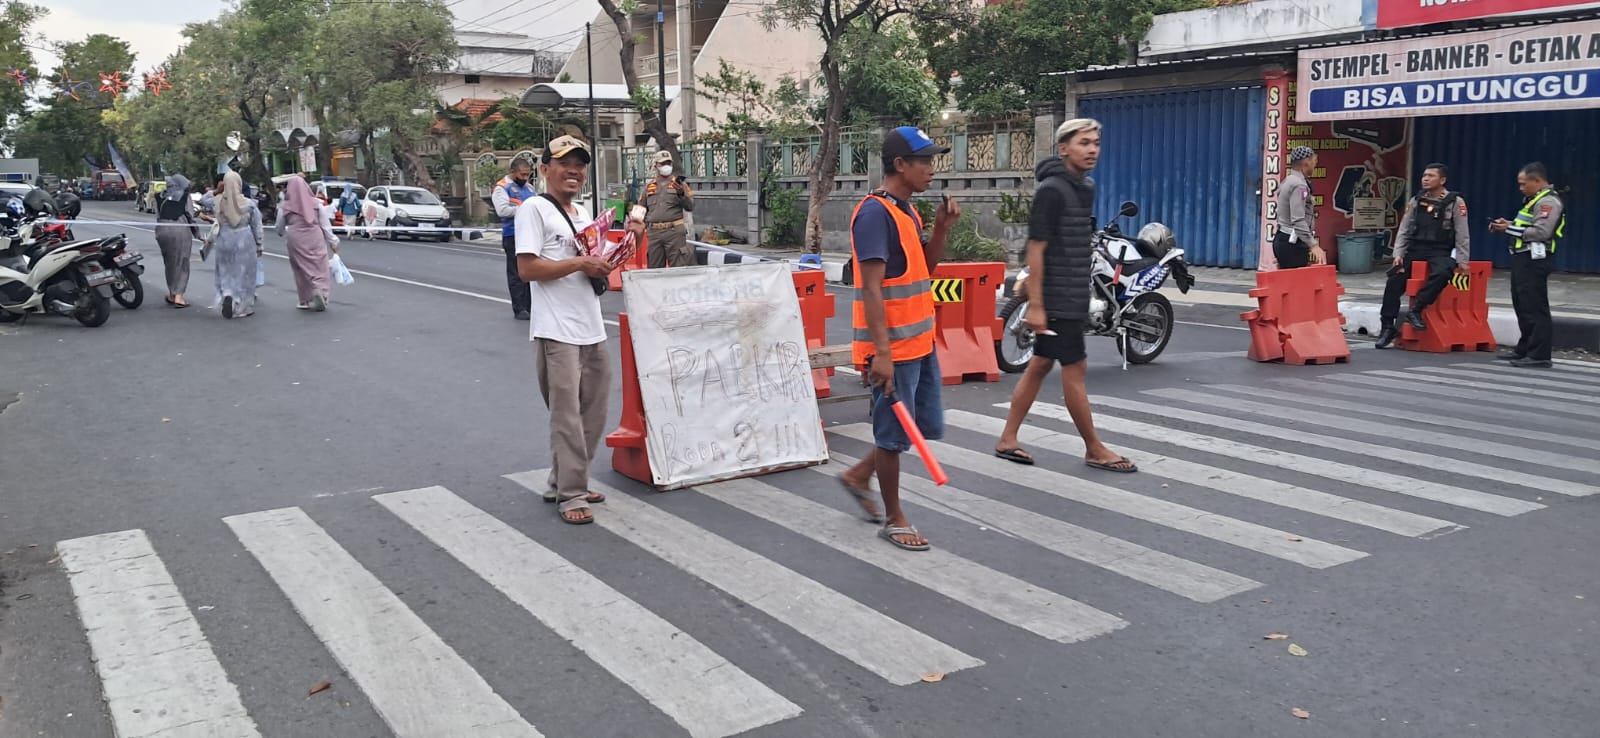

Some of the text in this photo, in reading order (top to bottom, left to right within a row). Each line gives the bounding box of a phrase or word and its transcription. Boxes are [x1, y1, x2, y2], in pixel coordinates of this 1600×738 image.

[1311, 53, 1389, 81] STEMPEL
[1407, 44, 1489, 72] BANNER
[1509, 35, 1582, 65] CETAK
[1343, 74, 1588, 109] BISA DITUNGGU
[1287, 125, 1312, 135] TROPHY
[1266, 87, 1280, 242] STEMPEL
